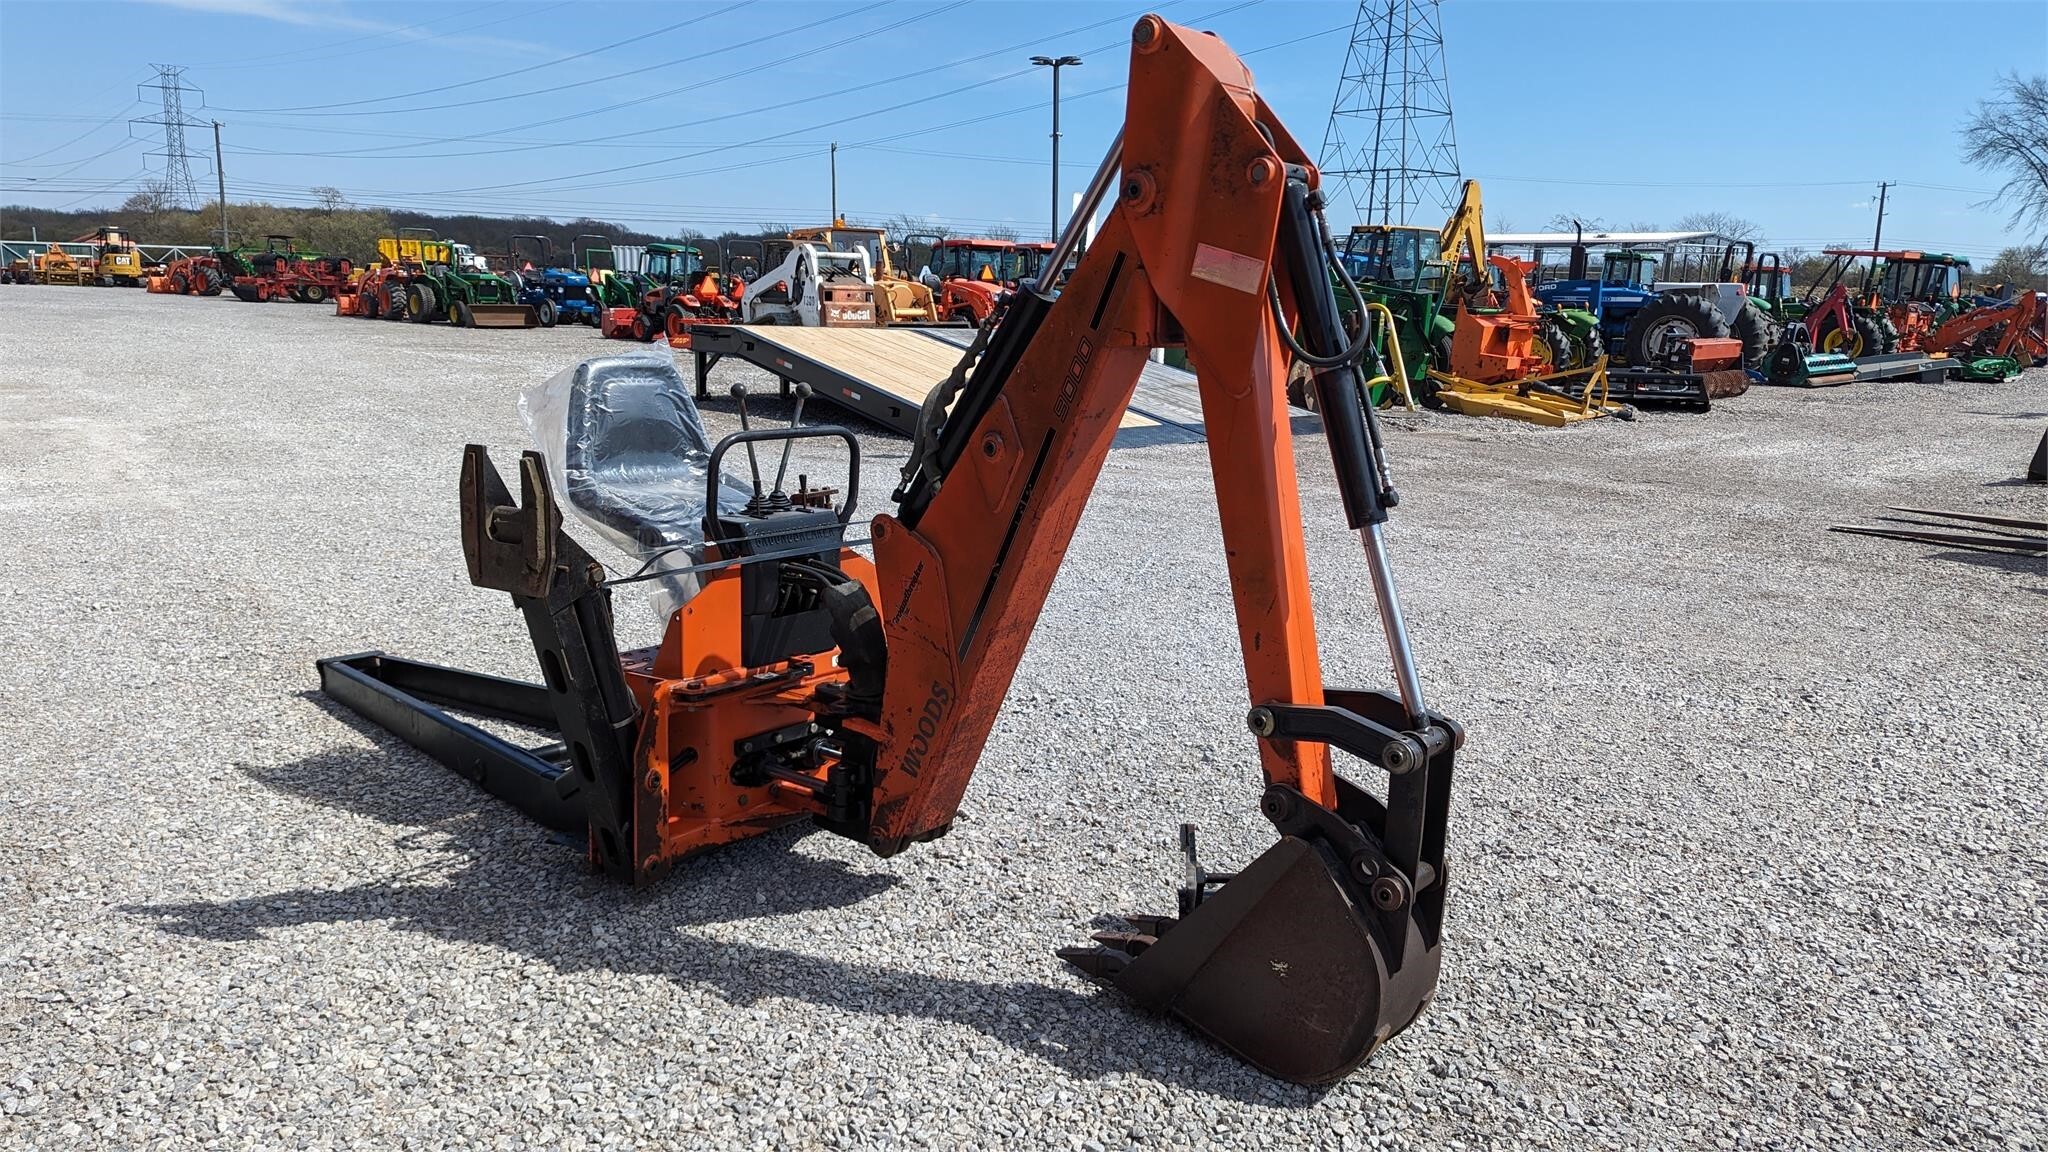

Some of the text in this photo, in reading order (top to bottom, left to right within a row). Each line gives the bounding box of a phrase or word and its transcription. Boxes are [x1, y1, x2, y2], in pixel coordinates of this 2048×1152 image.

[116, 256, 130, 265] CAT
[1535, 283, 1557, 291] ORD
[1053, 335, 1094, 424] 9000
[900, 679, 949, 779] WOODS
